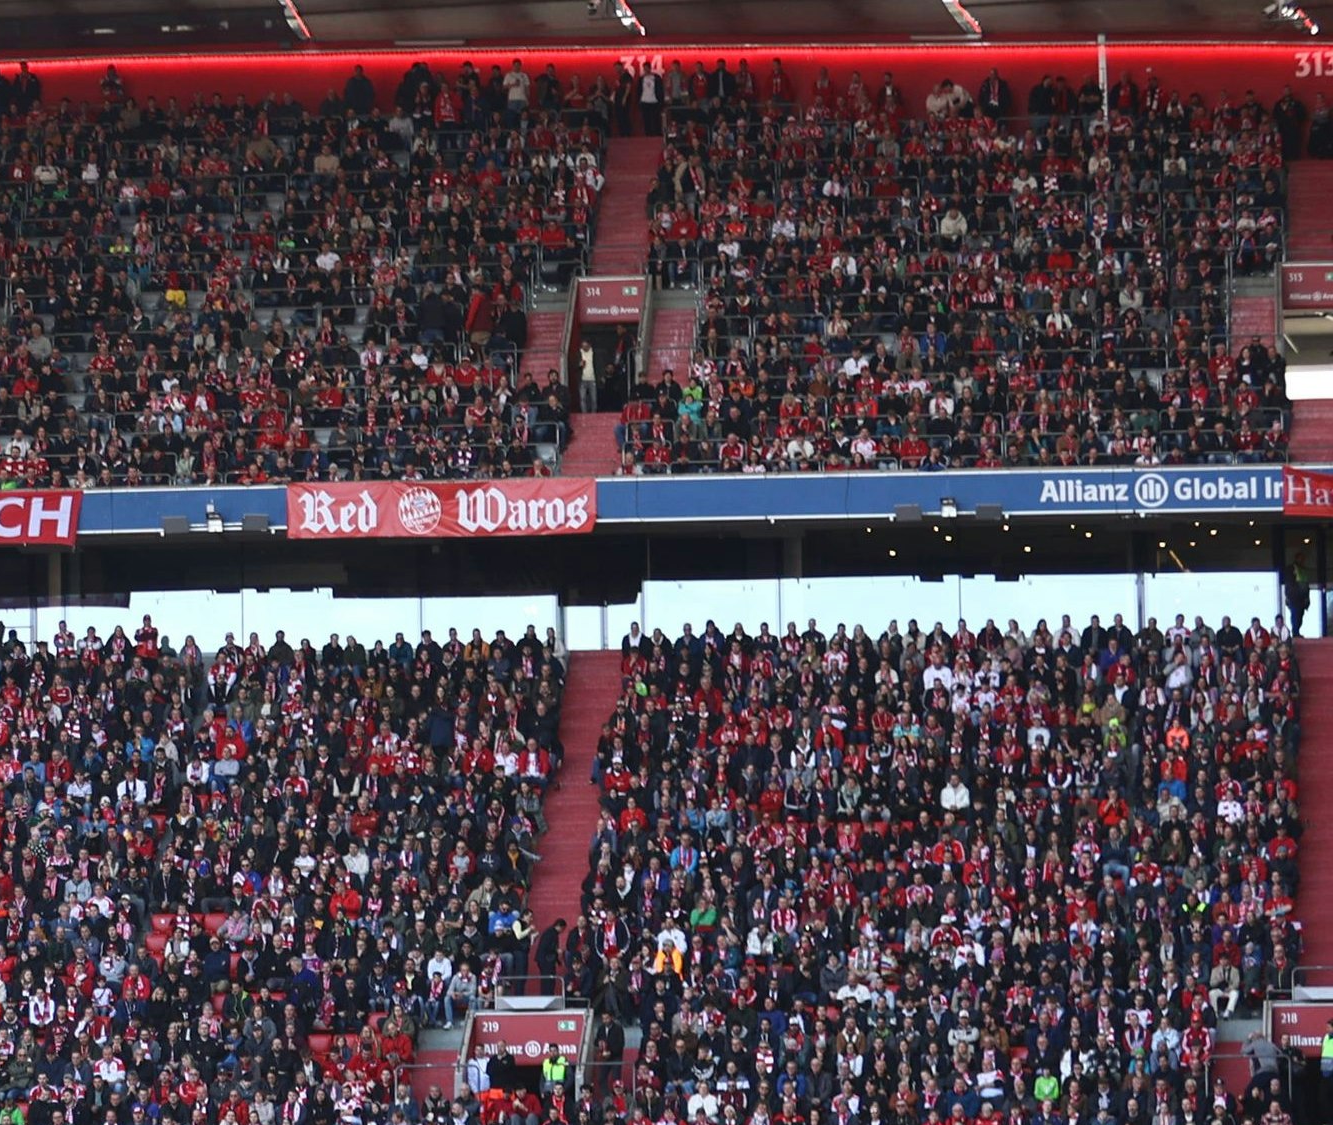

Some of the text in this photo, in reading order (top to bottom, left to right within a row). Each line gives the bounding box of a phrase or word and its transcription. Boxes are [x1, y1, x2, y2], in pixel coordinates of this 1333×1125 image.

[1040, 476, 1257, 502] Allianz Global
[297, 490, 378, 533] Red
[482, 1021, 499, 1032] 219
[1281, 1012, 1298, 1024] 218
